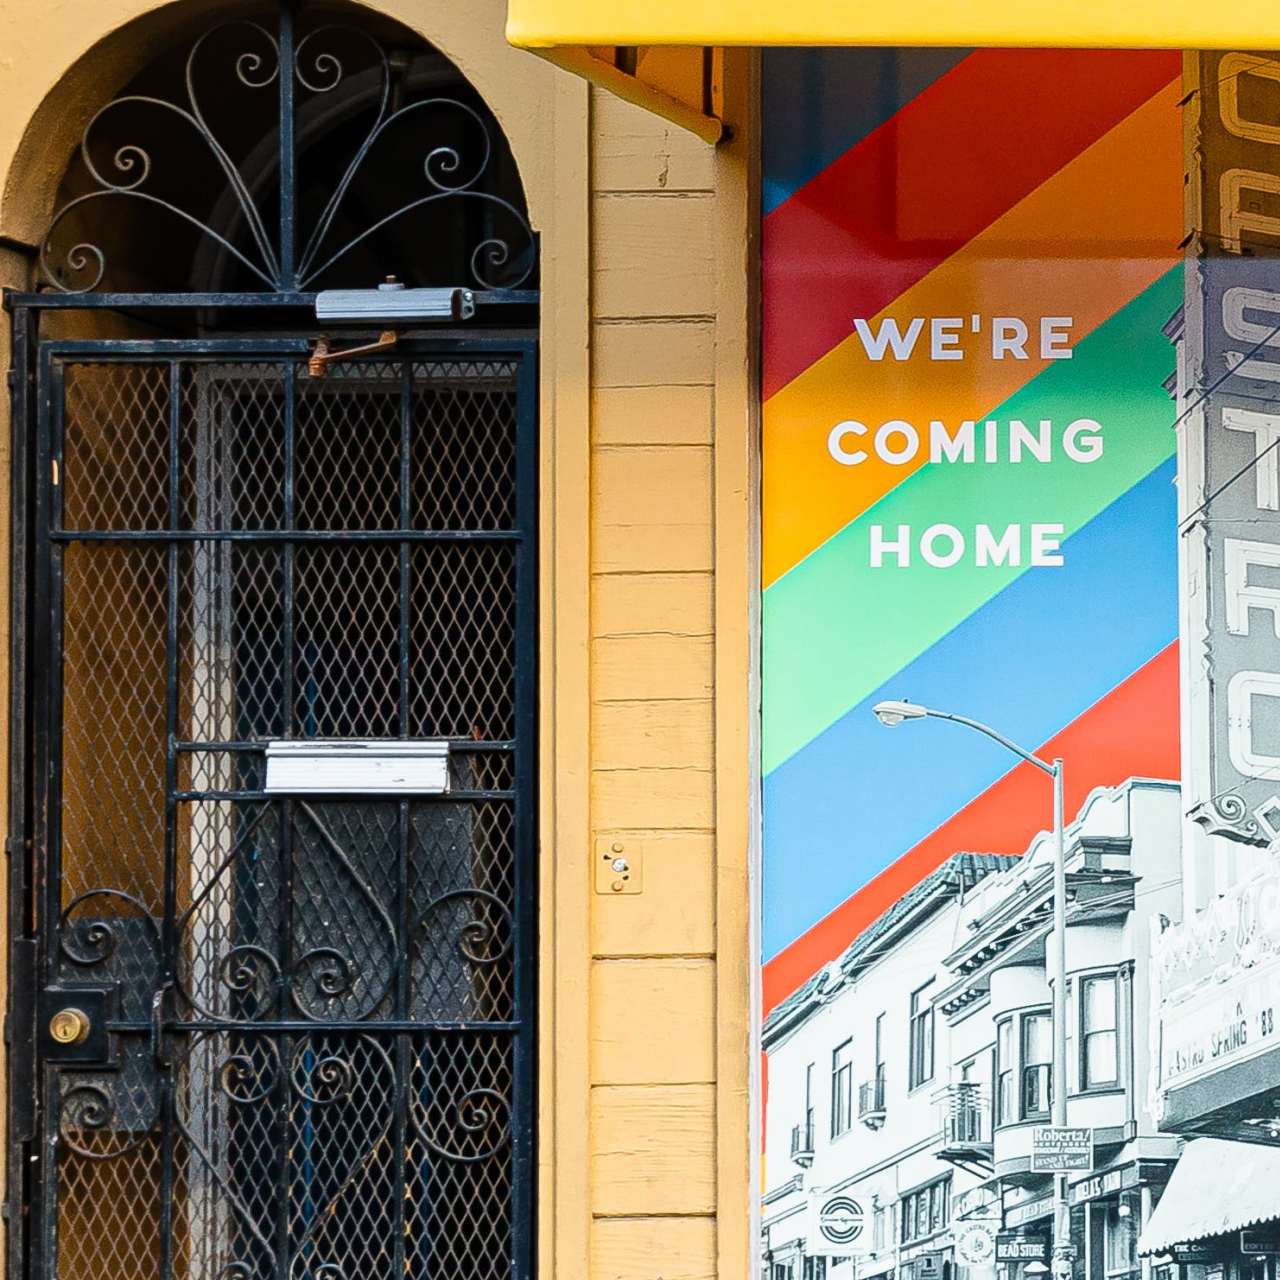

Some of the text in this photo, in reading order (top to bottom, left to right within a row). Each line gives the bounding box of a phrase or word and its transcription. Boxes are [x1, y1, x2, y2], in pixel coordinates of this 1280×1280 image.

[853, 314, 1074, 361] WE'RE
[827, 418, 1104, 466] COMING
[869, 522, 1066, 570] HOME
